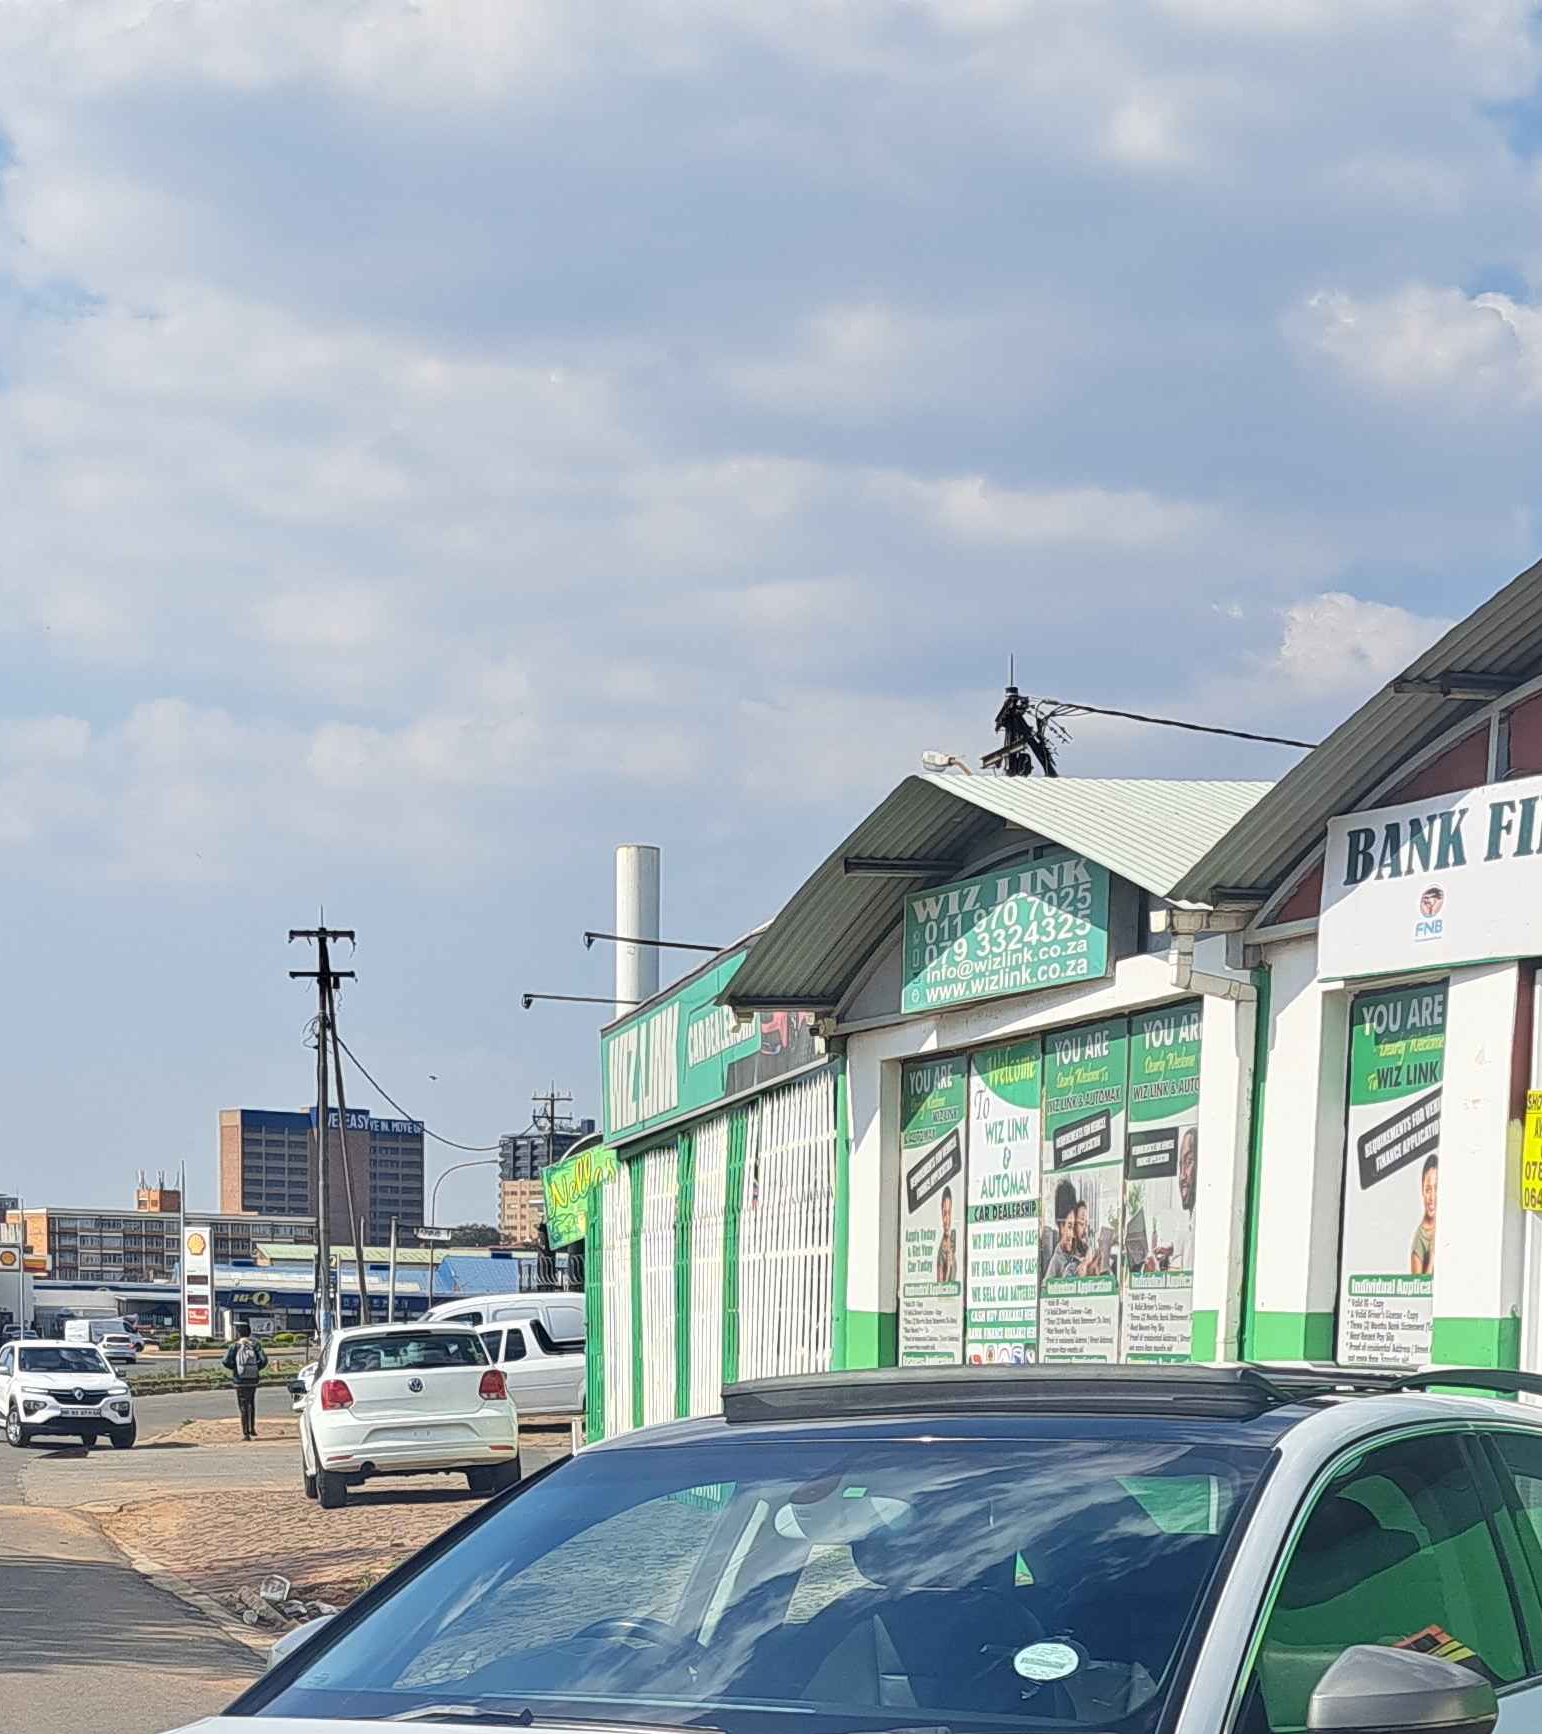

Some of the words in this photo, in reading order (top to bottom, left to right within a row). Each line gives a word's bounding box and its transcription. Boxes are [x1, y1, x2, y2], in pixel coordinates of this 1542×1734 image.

[1343, 806, 1469, 887] BANK
[910, 884, 982, 924] WIZ
[995, 858, 1092, 904] LINK
[924, 914, 962, 945] 011
[973, 900, 1018, 934] 970
[975, 909, 1092, 957] 3324325
[1415, 919, 1444, 938] FNB
[926, 939, 1088, 983] info@wizlink.co.za
[926, 958, 1088, 1003] www.wizlink.co.za
[1363, 1000, 1403, 1036] YOU
[1407, 994, 1444, 1030] ARE
[1054, 1036, 1081, 1066] YOU
[1085, 1030, 1109, 1059] ARE
[1144, 1017, 1174, 1049] YOU
[910, 1068, 931, 1095] YOU
[934, 1064, 953, 1089] ARE
[1377, 1065, 1402, 1089] WIZ
[1406, 1060, 1439, 1086] LINK
[985, 1119, 1004, 1145] WIZ
[1007, 1116, 1029, 1142] LINK
[981, 1171, 1031, 1199] AUTOMAX
[1524, 1187, 1542, 1208] 064
[974, 1204, 990, 1222] CAR
[993, 1200, 1036, 1221] DEALERSHIP
